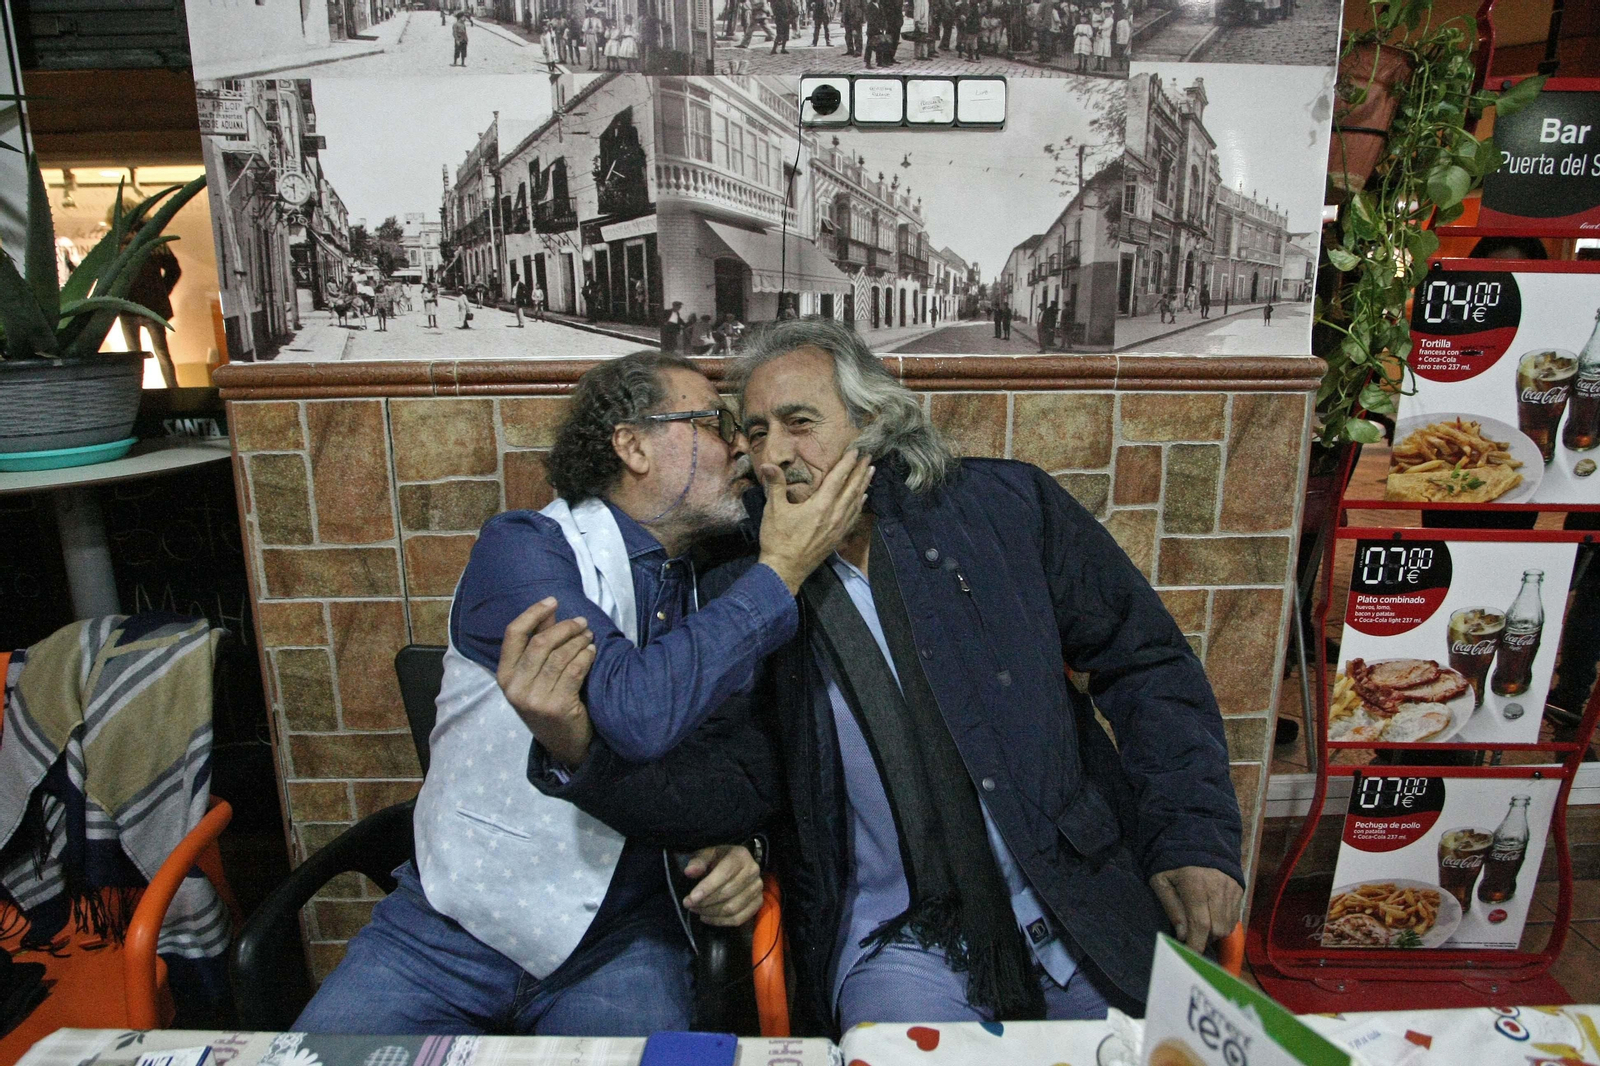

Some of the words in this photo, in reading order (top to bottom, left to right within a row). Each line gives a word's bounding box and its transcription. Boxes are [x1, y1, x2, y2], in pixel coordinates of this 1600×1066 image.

[1540, 118, 1591, 144] Bar
[1497, 151, 1555, 174] Puerta
[1560, 153, 1587, 176] del
[1591, 154, 1600, 176] S
[1420, 339, 1451, 348] Tortilla
[1419, 348, 1446, 356] francesa
[1357, 595, 1378, 604] Plato
[1379, 596, 1426, 604] combinado
[1355, 821, 1388, 829] Pechuga
